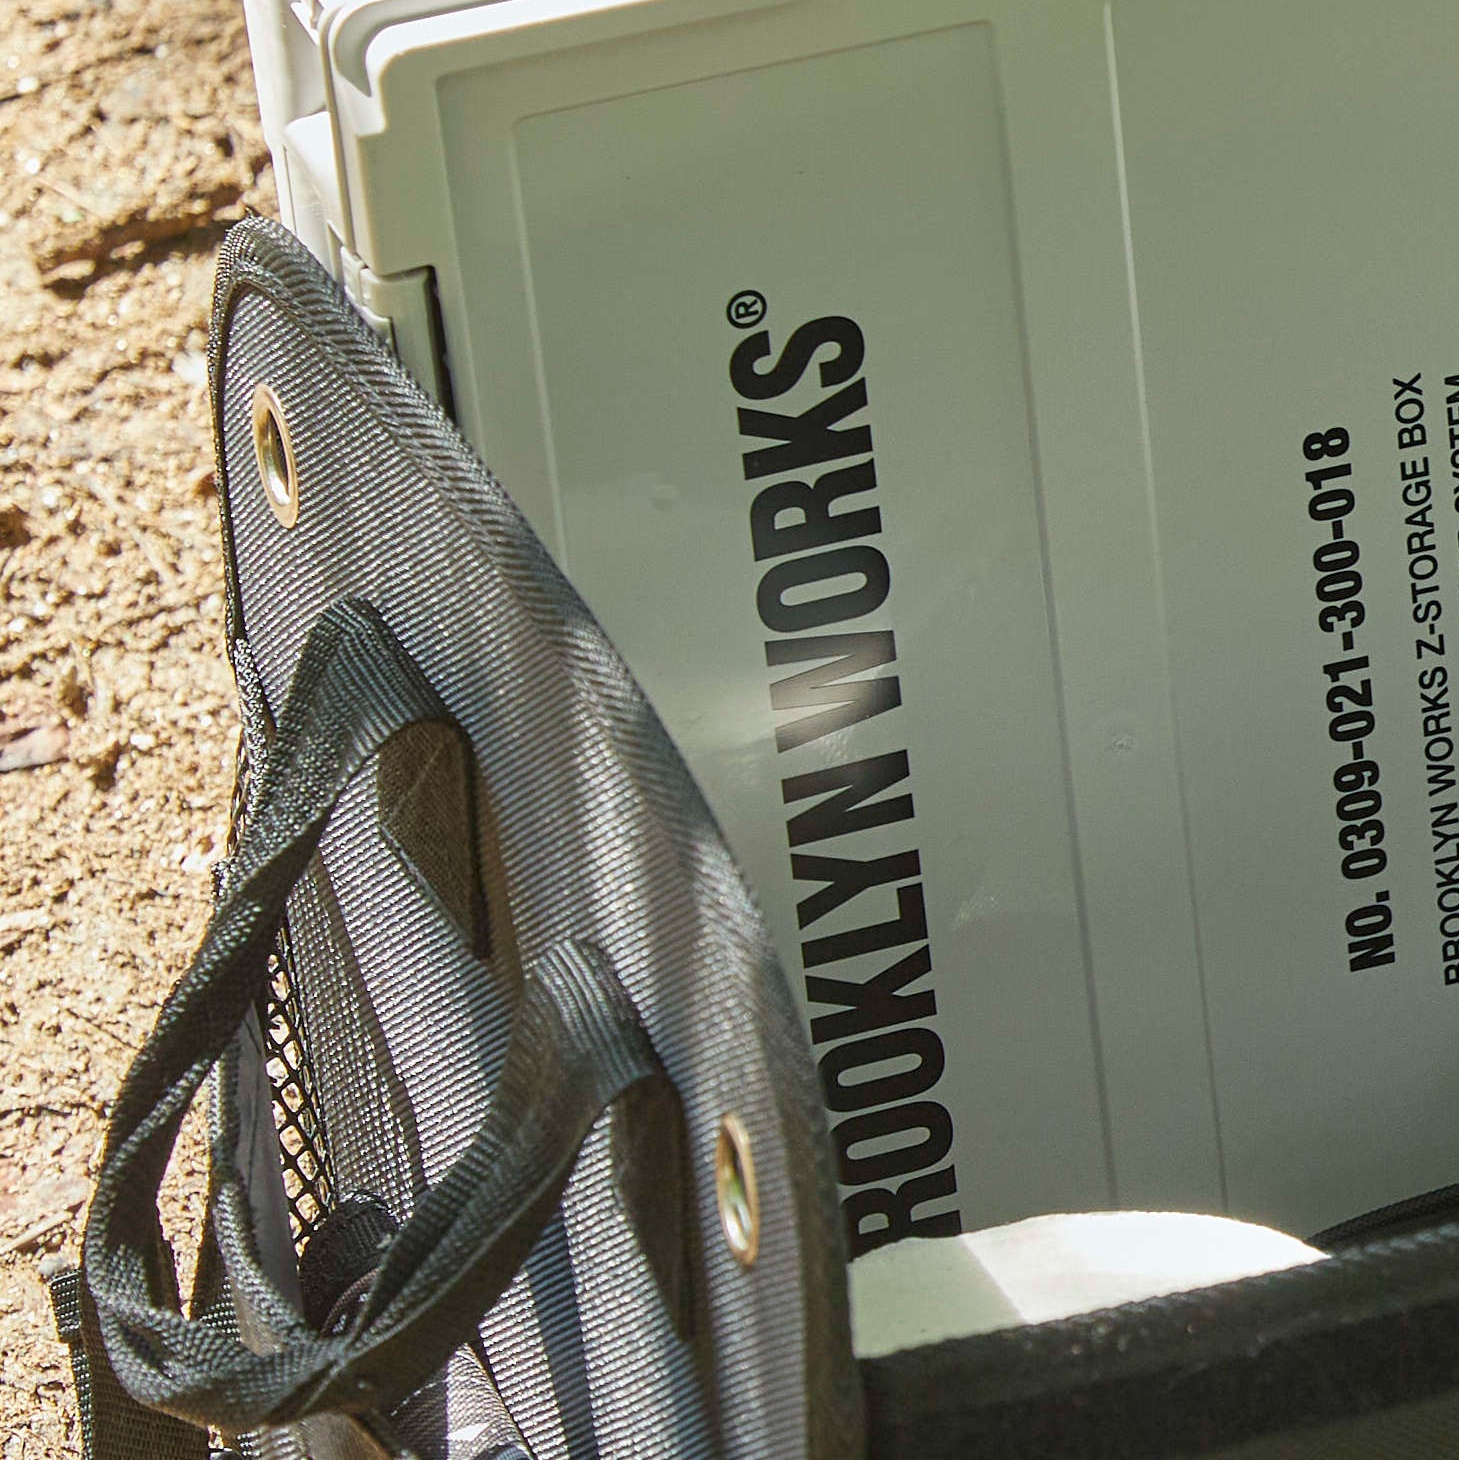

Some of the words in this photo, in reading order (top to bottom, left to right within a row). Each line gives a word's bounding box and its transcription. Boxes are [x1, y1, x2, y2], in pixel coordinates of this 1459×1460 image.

[1392, 372, 1428, 450] BOX
[1399, 456, 1446, 660] Z-STORAGE
[1302, 426, 1388, 880] 0309-021-300-018
[1418, 666, 1457, 797] WORKS
[782, 748, 962, 1264] ROOKLYN
[1344, 889, 1396, 973] NO.
